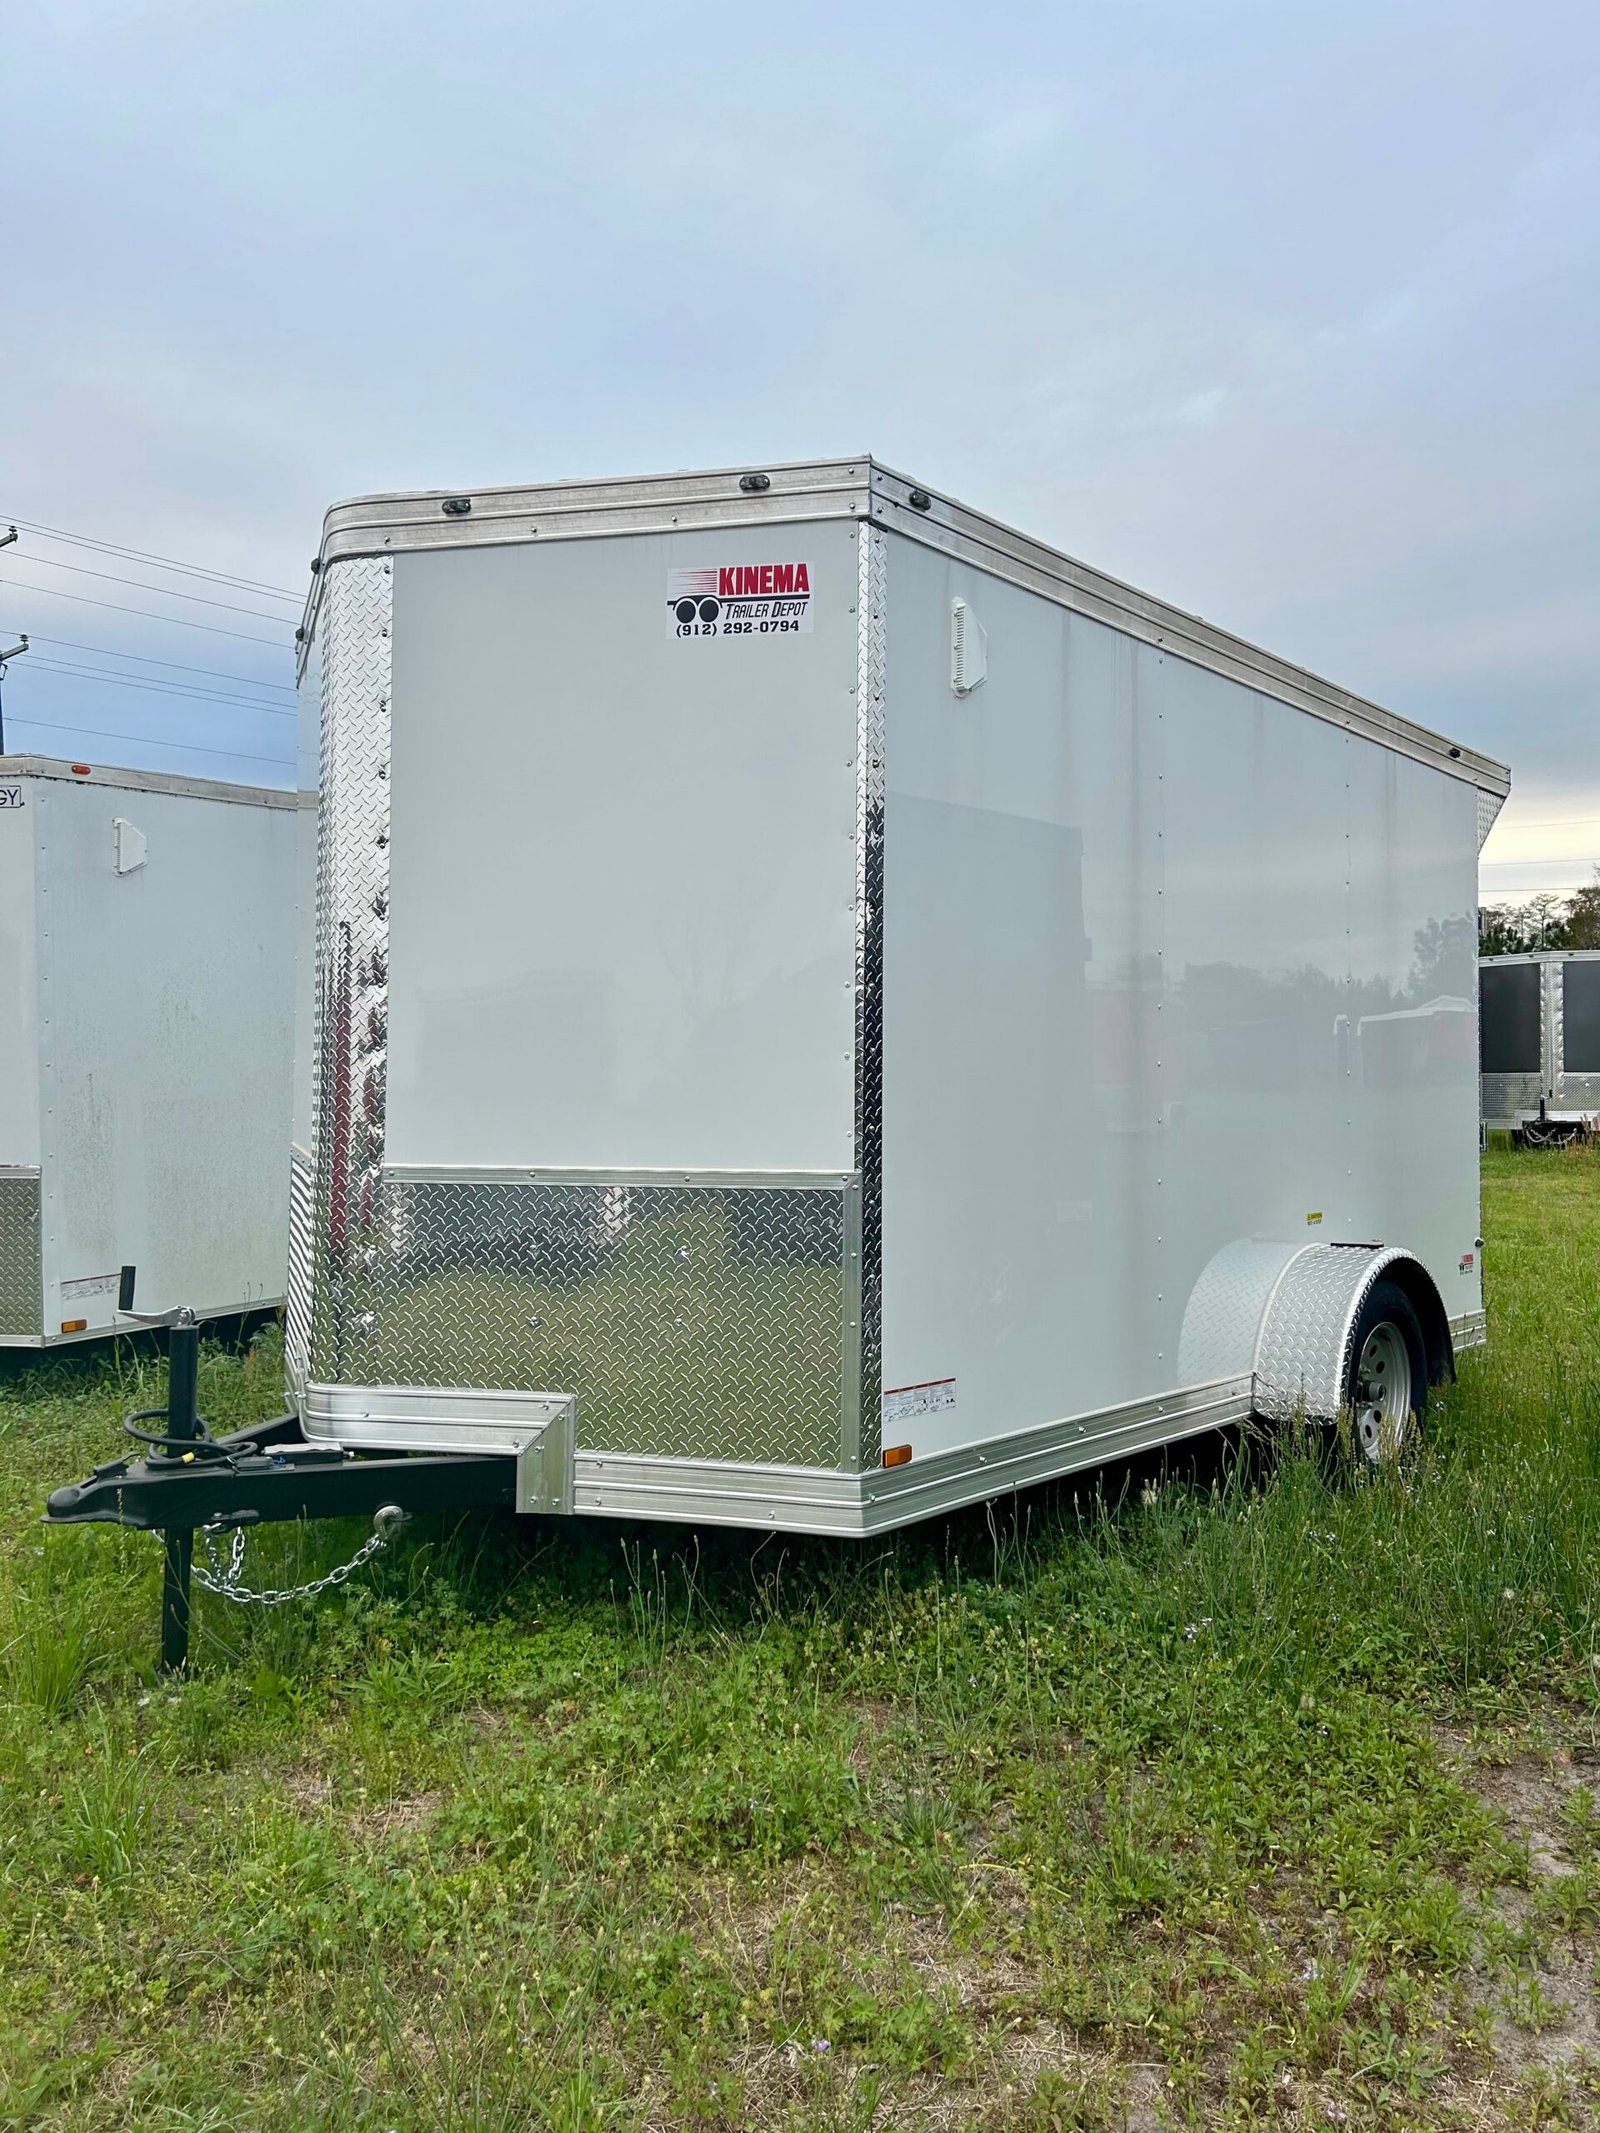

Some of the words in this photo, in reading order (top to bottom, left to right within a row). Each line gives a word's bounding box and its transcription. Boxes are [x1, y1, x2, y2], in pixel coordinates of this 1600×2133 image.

[719, 563, 810, 596] KINEMA
[726, 603, 769, 620] TRAILER
[771, 601, 808, 618] DEPOT
[676, 623, 717, 638] (912)
[723, 620, 799, 634] 292-0794
